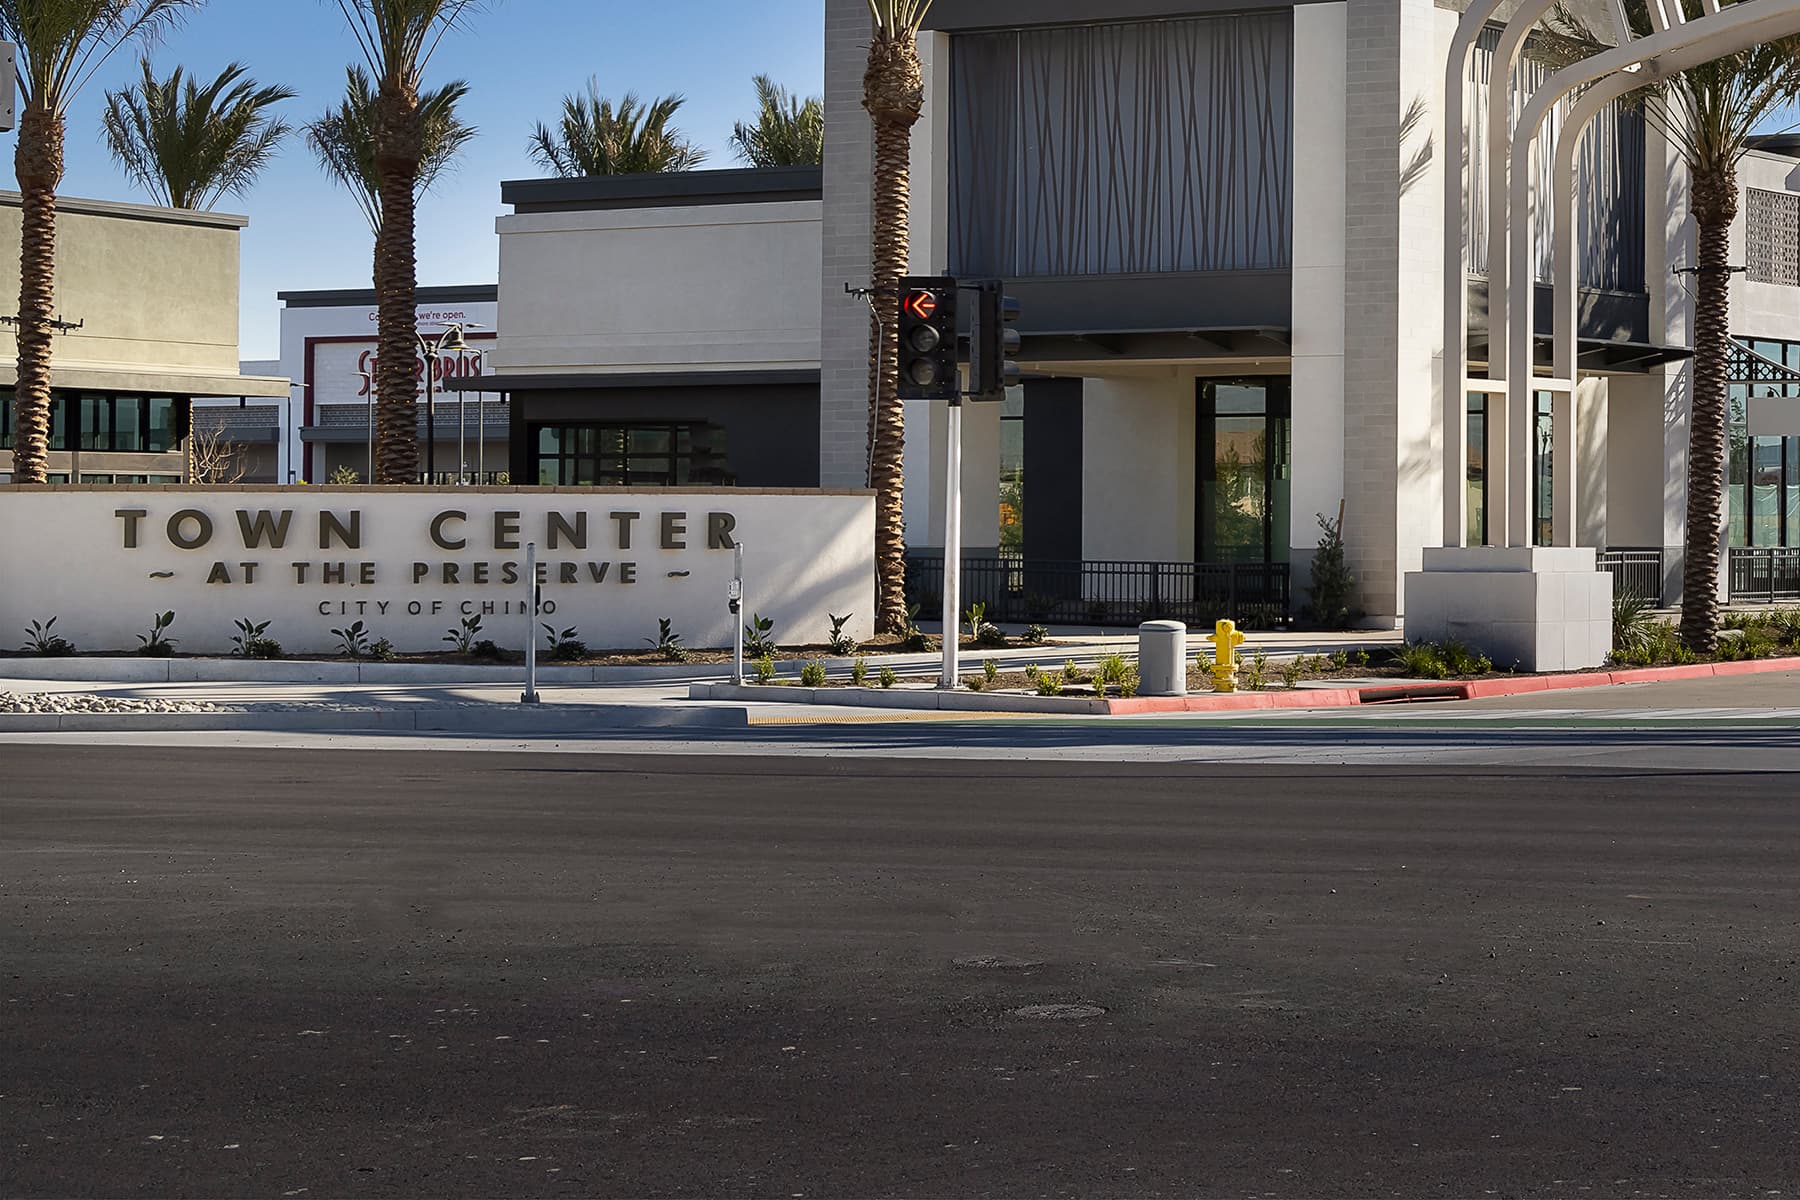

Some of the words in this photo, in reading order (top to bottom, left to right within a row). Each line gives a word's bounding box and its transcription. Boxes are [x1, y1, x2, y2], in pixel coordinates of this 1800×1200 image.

[114, 509, 361, 550] TOWN
[430, 510, 736, 550] CENTER
[206, 561, 259, 584] AT
[291, 561, 376, 584] THE
[413, 561, 637, 584] PRESERVE
[318, 600, 390, 616] CITY
[407, 600, 443, 616] OF
